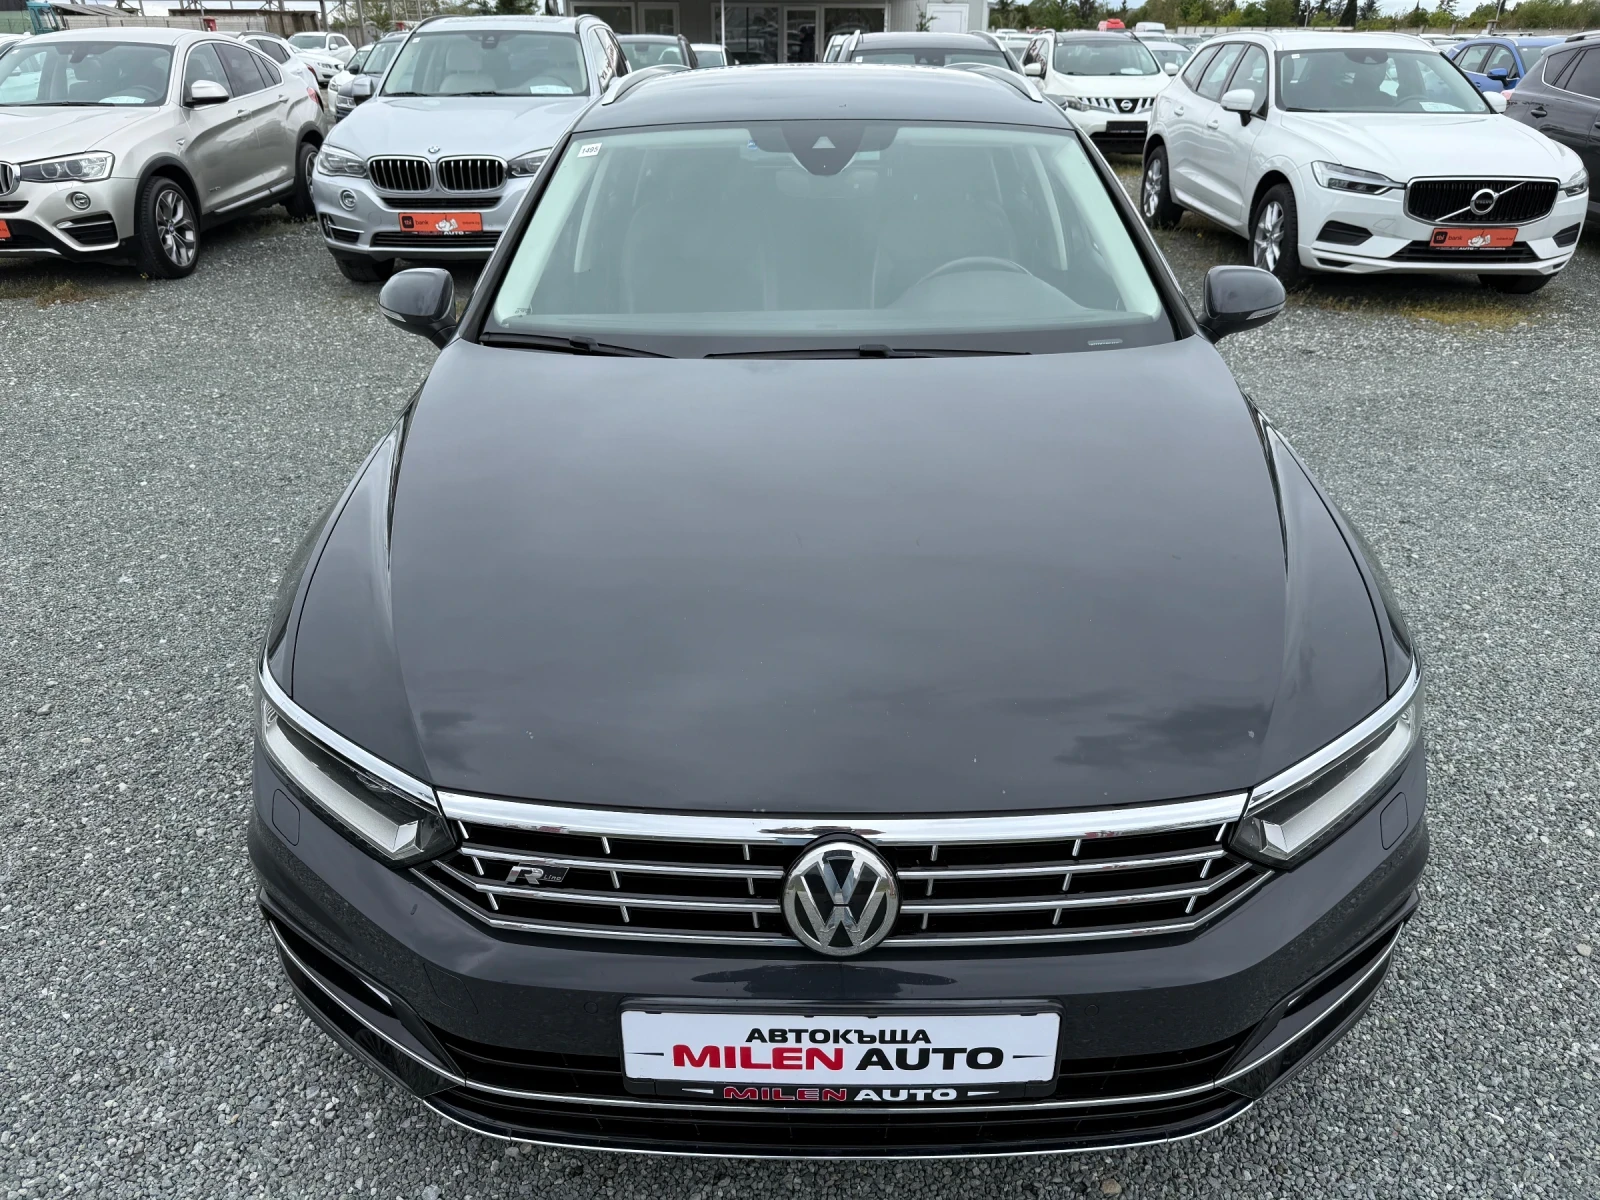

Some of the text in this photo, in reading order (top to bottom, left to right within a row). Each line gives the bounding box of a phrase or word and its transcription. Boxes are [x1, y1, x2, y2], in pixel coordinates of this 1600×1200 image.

[505, 866, 544, 885] R
[672, 1044, 1004, 1071] MILEN AUTO
[723, 1086, 957, 1102] MILEN AUTO
